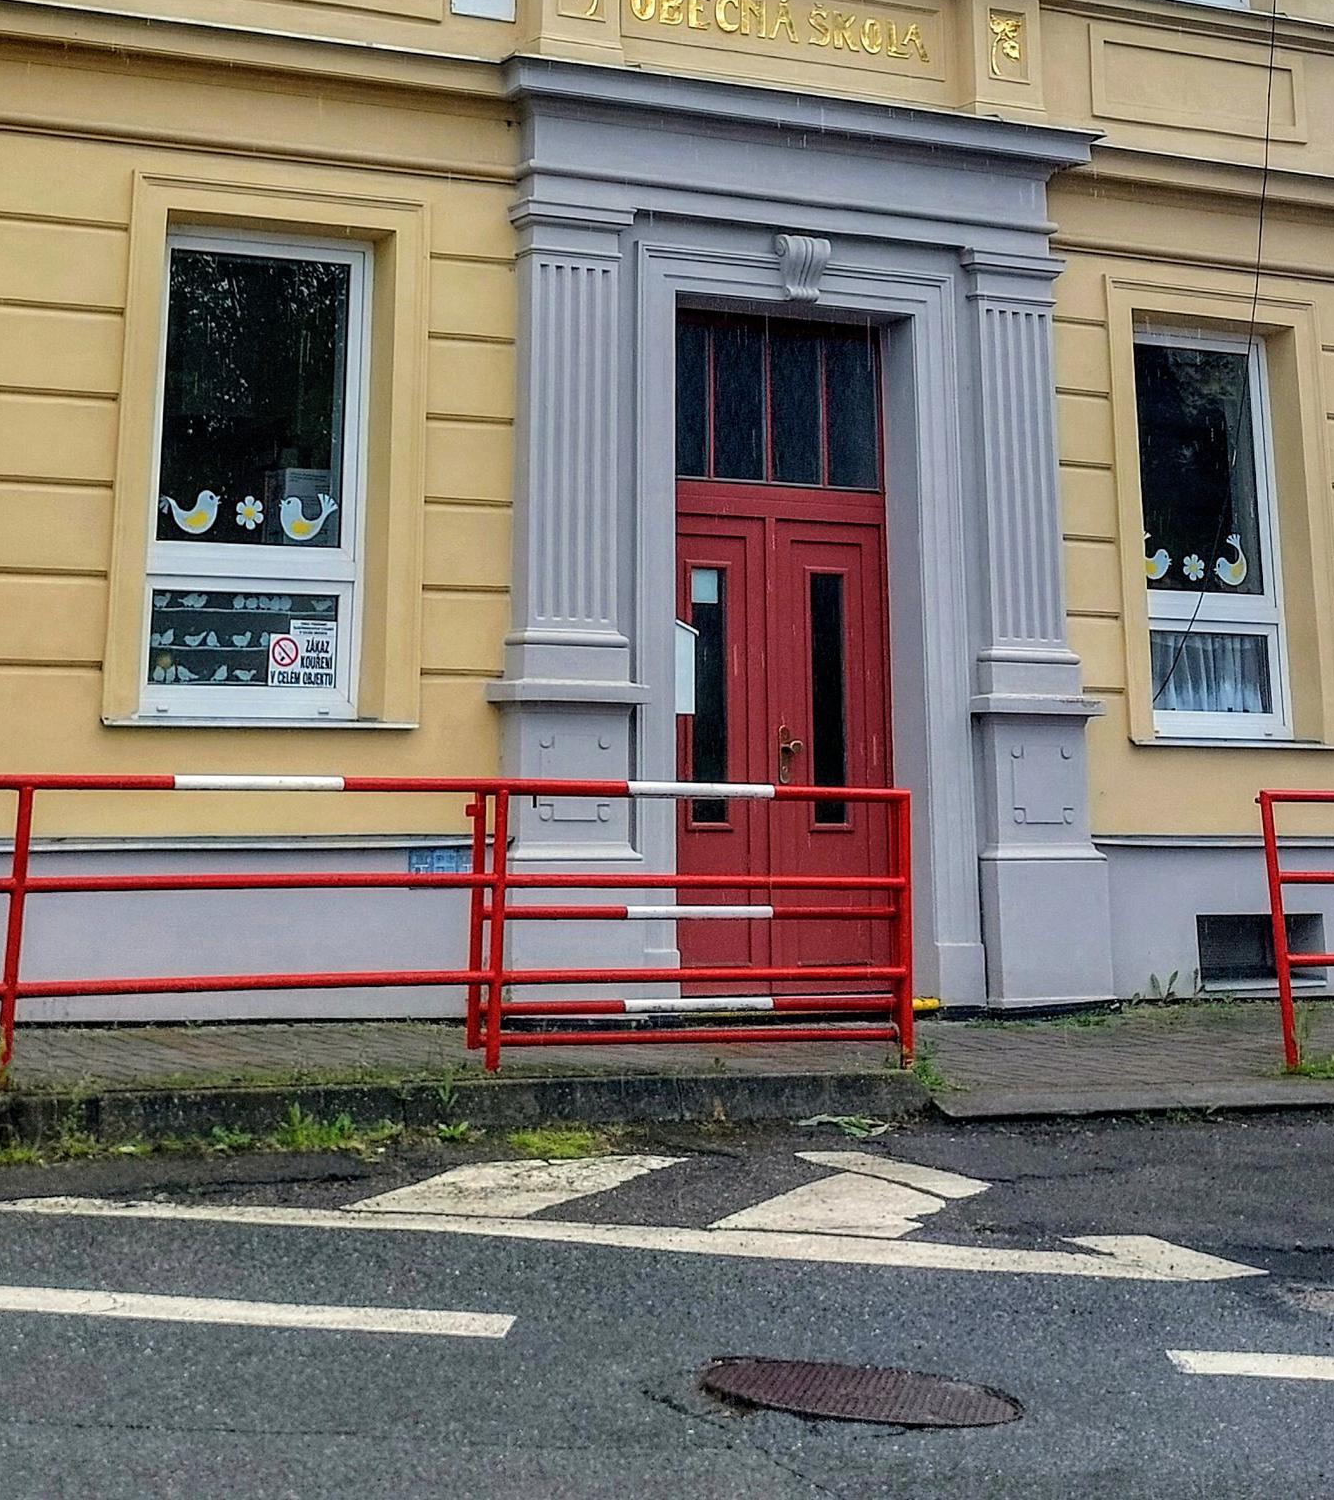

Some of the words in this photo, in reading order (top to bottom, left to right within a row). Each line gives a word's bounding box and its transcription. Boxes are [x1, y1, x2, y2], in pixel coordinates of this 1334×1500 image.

[808, 3, 930, 62] ŠKOLA
[305, 637, 330, 653] ZÁKAZ
[270, 670, 276, 684] V
[302, 672, 334, 686] OBJEKTU
